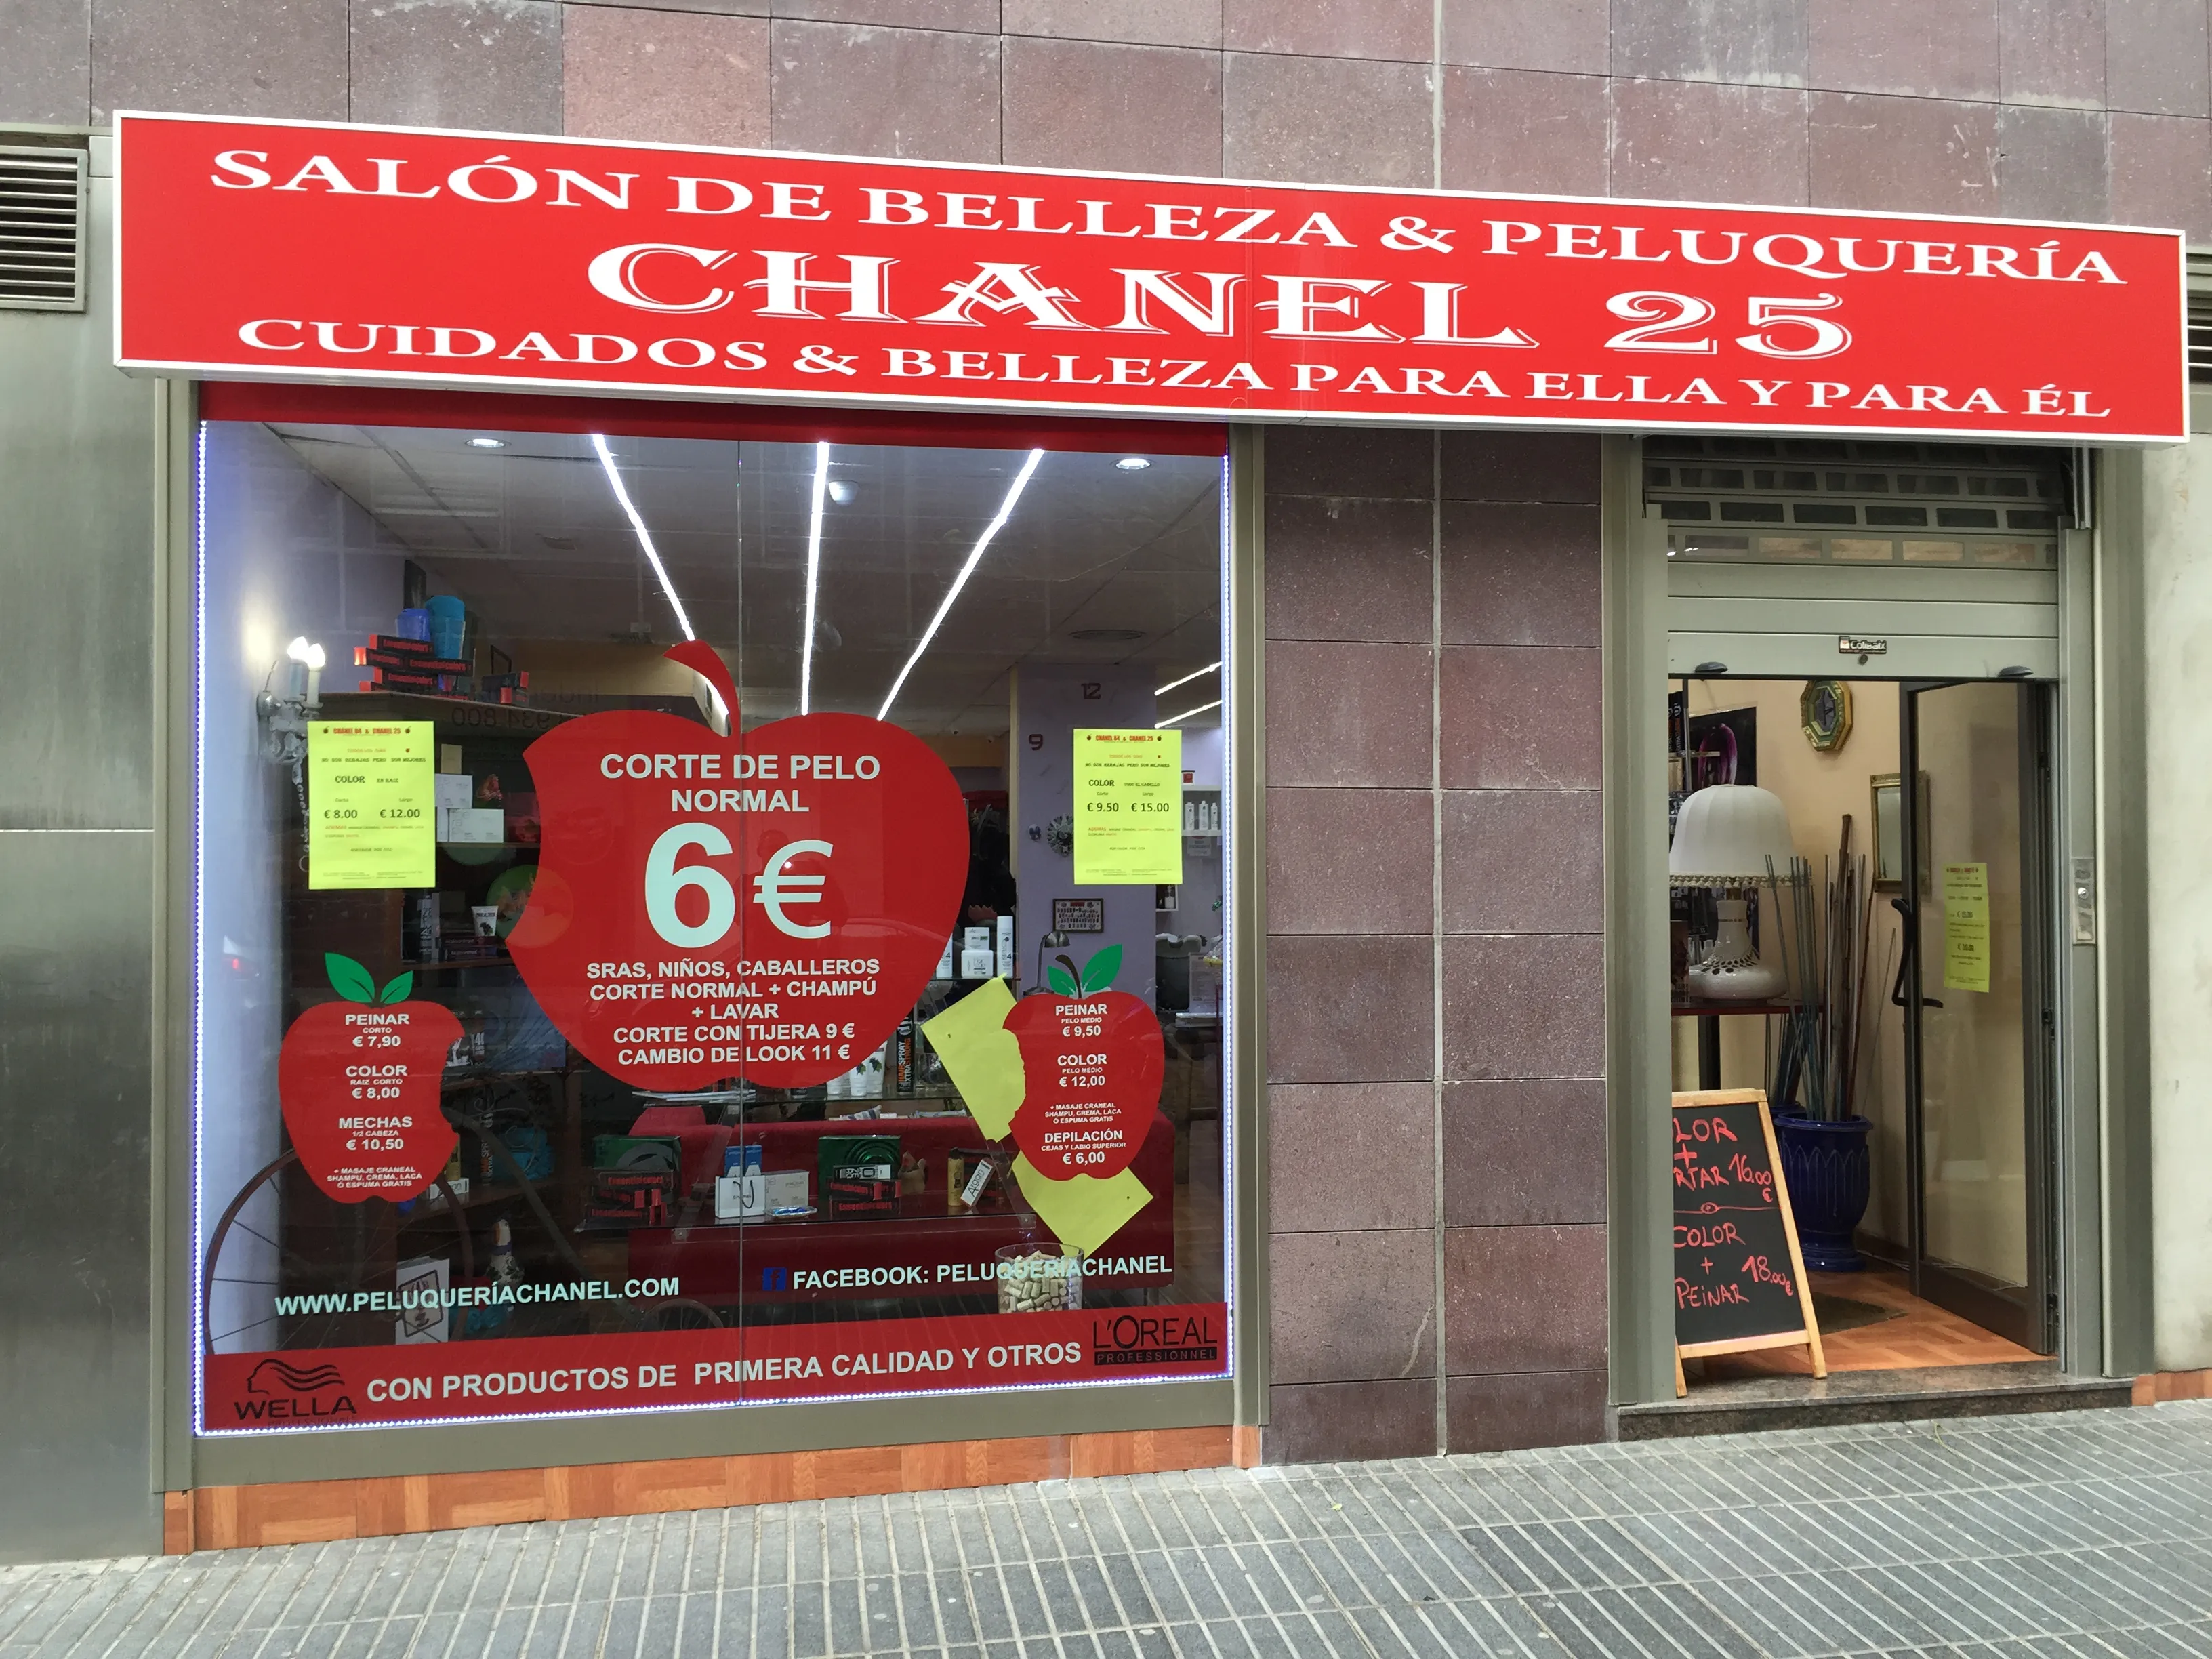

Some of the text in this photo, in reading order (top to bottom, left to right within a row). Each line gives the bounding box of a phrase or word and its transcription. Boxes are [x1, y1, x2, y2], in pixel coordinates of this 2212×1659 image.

[211, 150, 2128, 285] SALÓN DE BELLEZA & PELUQUERÍA
[588, 243, 1853, 360] CHANEL 25
[239, 320, 2110, 417] CUIDADOS & BELLEZA PARA ELLA Y PARA ÉL
[1081, 682, 1101, 699] 12
[1029, 733, 1044, 751] 9
[601, 754, 880, 779] CORTE DE PELO
[335, 775, 365, 783] COLOR
[672, 789, 809, 812] NORMAL
[1087, 803, 1169, 812] € 9.50 € 15.00
[324, 809, 420, 819] € 8.00 € 12.00
[645, 822, 834, 948] 6 €
[587, 958, 880, 980] SRAS, NIÑOS, CABALLEROS
[590, 977, 876, 1000] CORTE NORMAL + CHAMPÚ
[692, 1004, 779, 1019] + LAVAR
[1055, 1004, 1108, 1016] PEINAR
[346, 1014, 409, 1025] PEINAR
[614, 1023, 855, 1043] CORTE CON TIJERA 9 €
[1062, 1025, 1101, 1038] € 9,50
[352, 1036, 401, 1048] € 7,90
[619, 1044, 850, 1065] CAMBIO DE LOOK 11 €
[1057, 1054, 1107, 1066] COLOR
[346, 1065, 407, 1077] COLOR
[1059, 1076, 1105, 1088] € 12,00
[352, 1087, 400, 1101] € 8,00
[339, 1116, 413, 1128] MECHAS
[1672, 1117, 1738, 1143] LOR
[1044, 1128, 1122, 1143] DEPILACIÓN
[346, 1139, 404, 1151] € 10,50
[1062, 1151, 1105, 1166] € 6,00
[967, 1169, 985, 1198] Argan
[1673, 1166, 1730, 1191] RTAR
[1673, 1222, 1746, 1248] COLOR
[1700, 1257, 1714, 1275] +
[794, 1265, 928, 1290] FACEBOOK:
[275, 1277, 679, 1315] WWW.PELUQUERÍACHANEL.COM
[1093, 1315, 1218, 1349] L'OREAL
[1097, 1349, 1215, 1364] PROFESSIONNEL
[367, 1342, 1082, 1402] CON PRODUCTOS DE PRIMERA CALIDAD Y OTROS
[234, 1395, 357, 1420] WELLA
